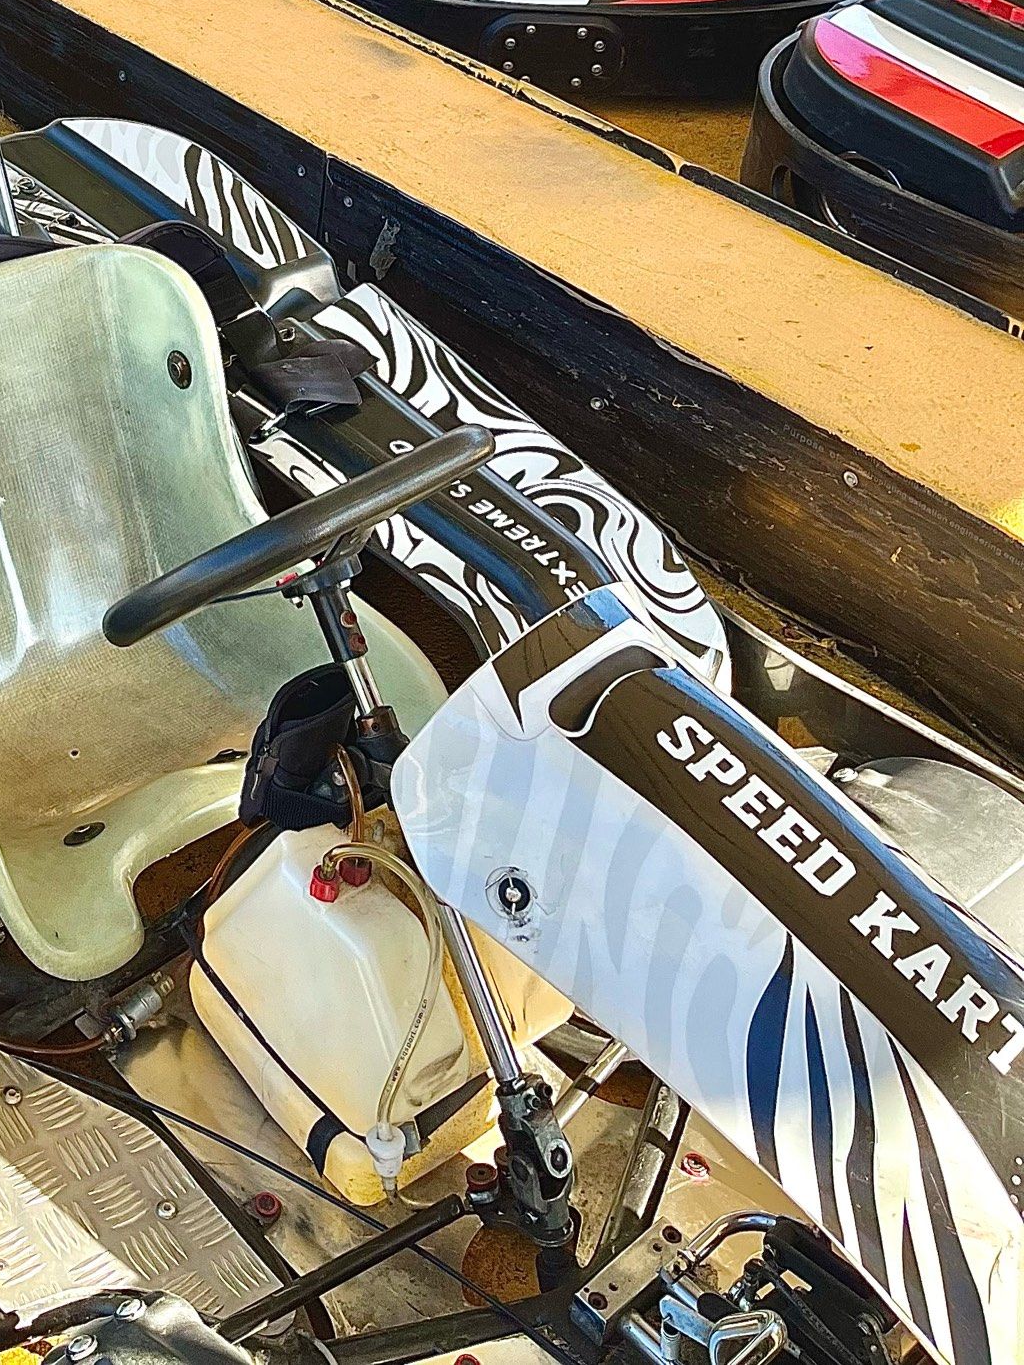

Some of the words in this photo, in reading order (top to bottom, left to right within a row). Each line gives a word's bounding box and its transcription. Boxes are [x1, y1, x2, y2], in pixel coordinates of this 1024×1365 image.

[467, 497, 589, 604] EXTREME
[946, 519, 1005, 557] engineering
[656, 715, 857, 898] SPEED
